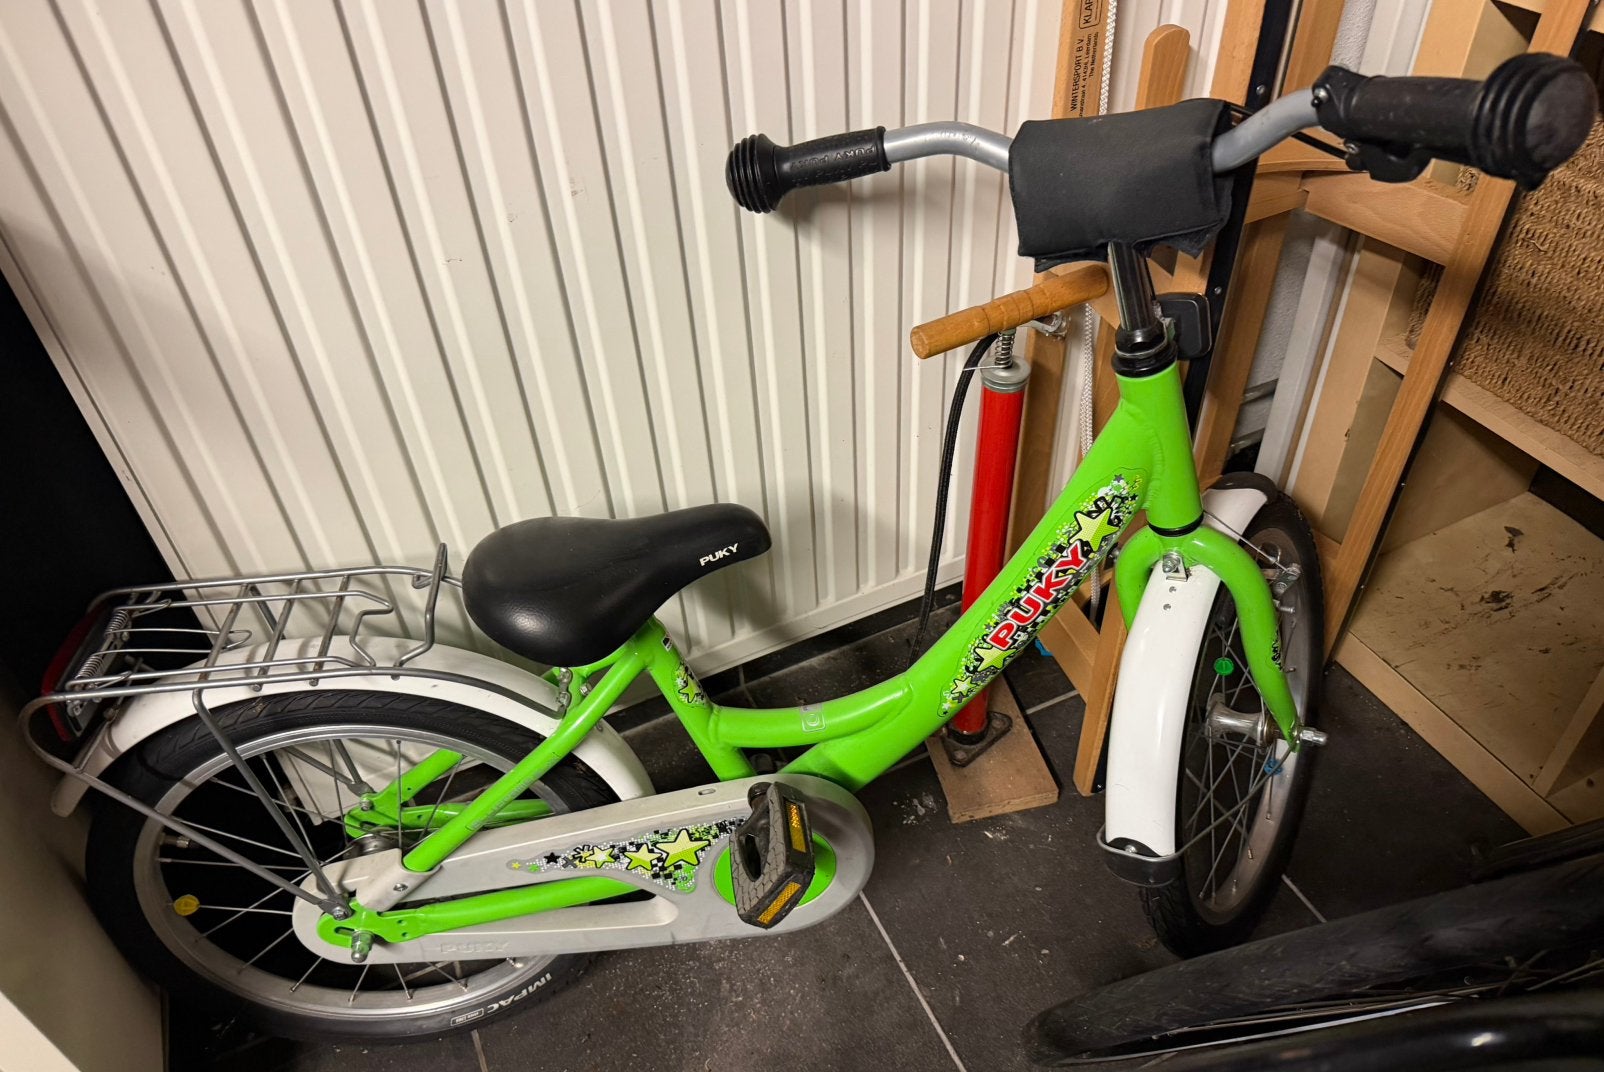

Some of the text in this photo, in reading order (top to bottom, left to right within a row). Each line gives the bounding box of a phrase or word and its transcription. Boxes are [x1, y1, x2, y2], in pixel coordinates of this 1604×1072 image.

[1090, 32, 1099, 66] Netherlands
[1070, 56, 1082, 112] WINTERSPORT
[835, 146, 876, 161] PUKY
[699, 542, 739, 567] PUKY
[985, 540, 1087, 650] PUKY
[486, 972, 553, 1014] IMPAC
